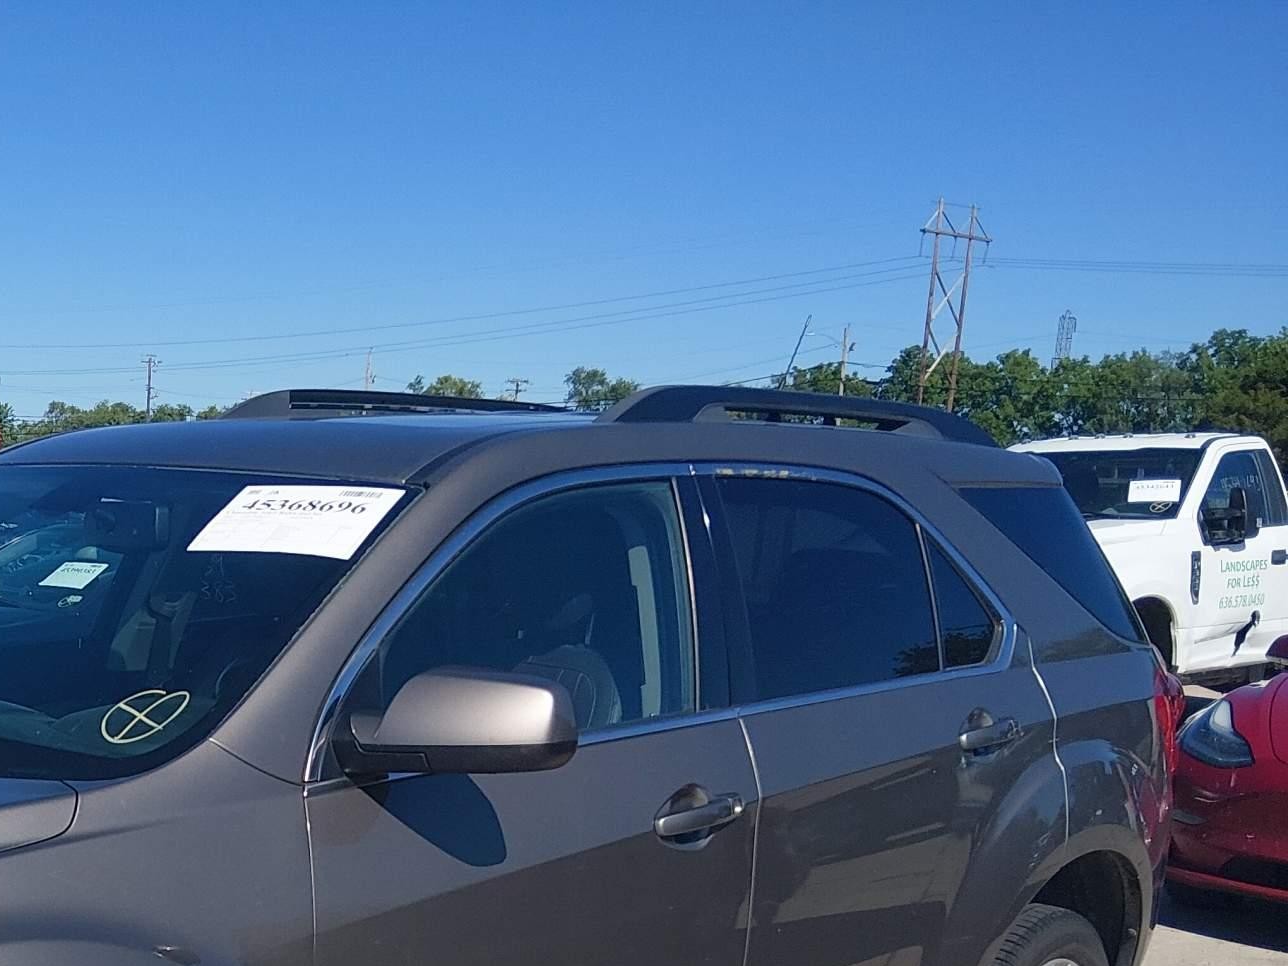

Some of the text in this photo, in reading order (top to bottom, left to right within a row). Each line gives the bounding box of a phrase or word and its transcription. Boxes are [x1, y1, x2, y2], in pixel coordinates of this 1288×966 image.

[242, 499, 368, 514] 45368696
[1220, 559, 1268, 573] LANDSCAPES
[1226, 577, 1241, 589] FOR
